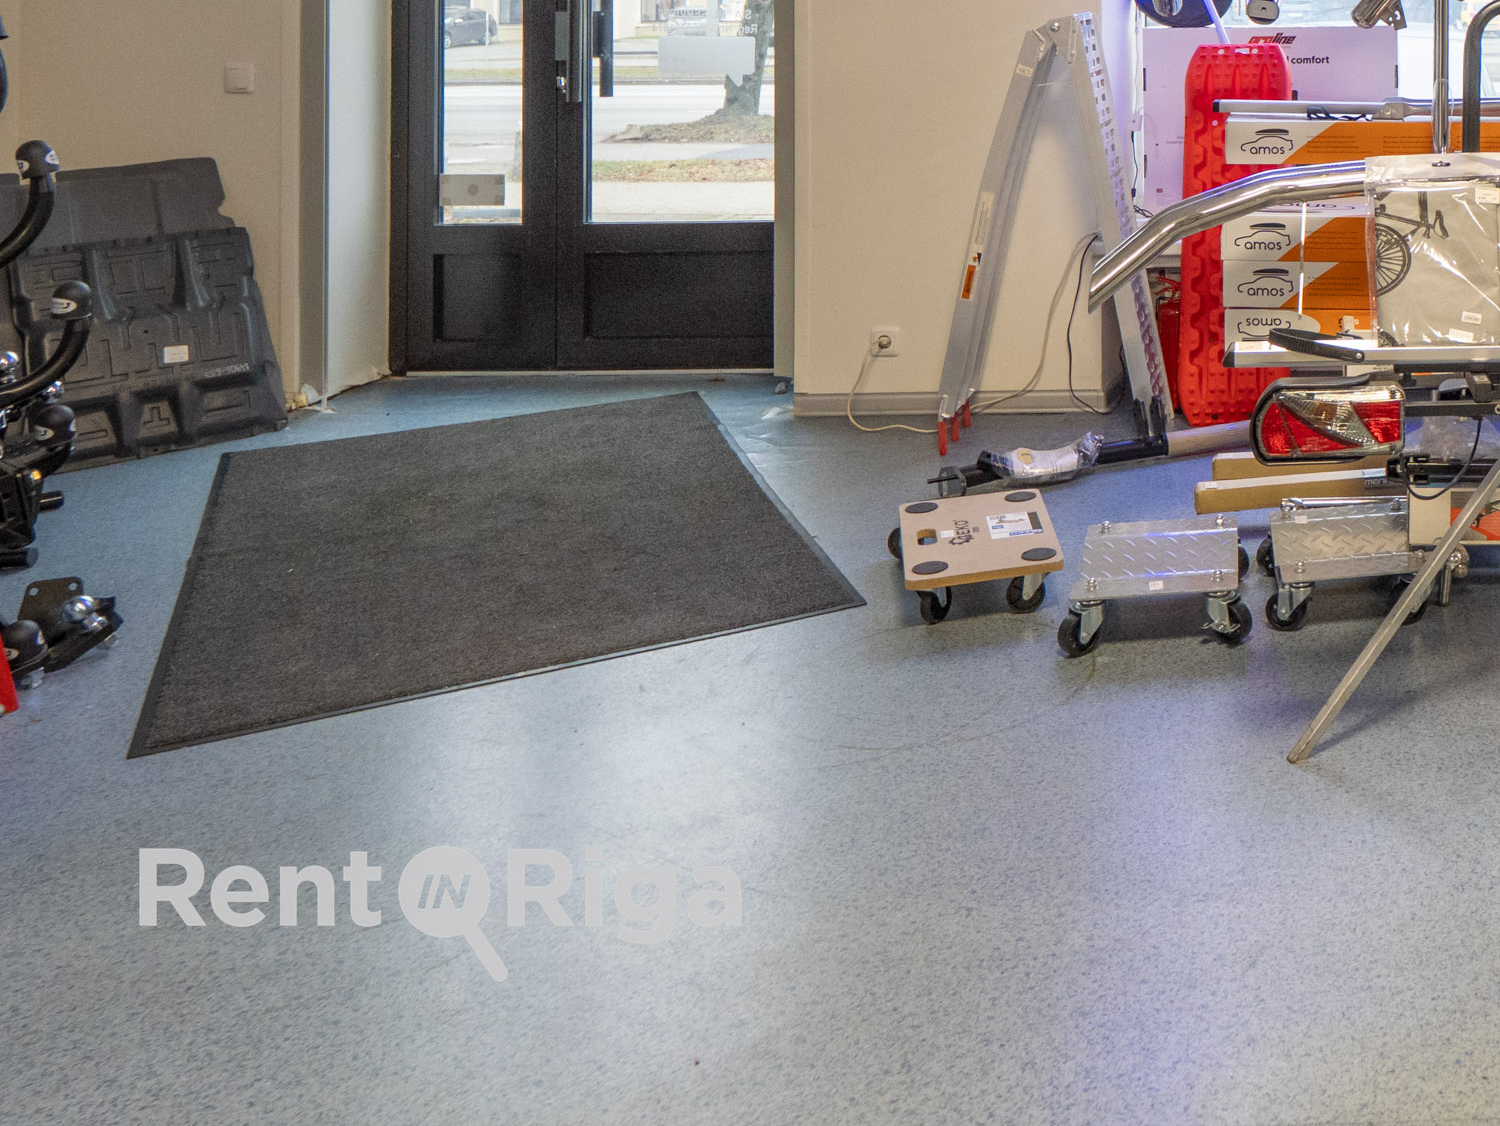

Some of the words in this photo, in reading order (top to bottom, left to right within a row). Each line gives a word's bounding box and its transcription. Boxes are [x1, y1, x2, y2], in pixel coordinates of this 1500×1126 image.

[1291, 55, 1330, 64] comfort
[1249, 142, 1285, 155] amos
[1244, 240, 1282, 251] amos
[1247, 286, 1285, 297] amos
[1245, 317, 1282, 326] amos
